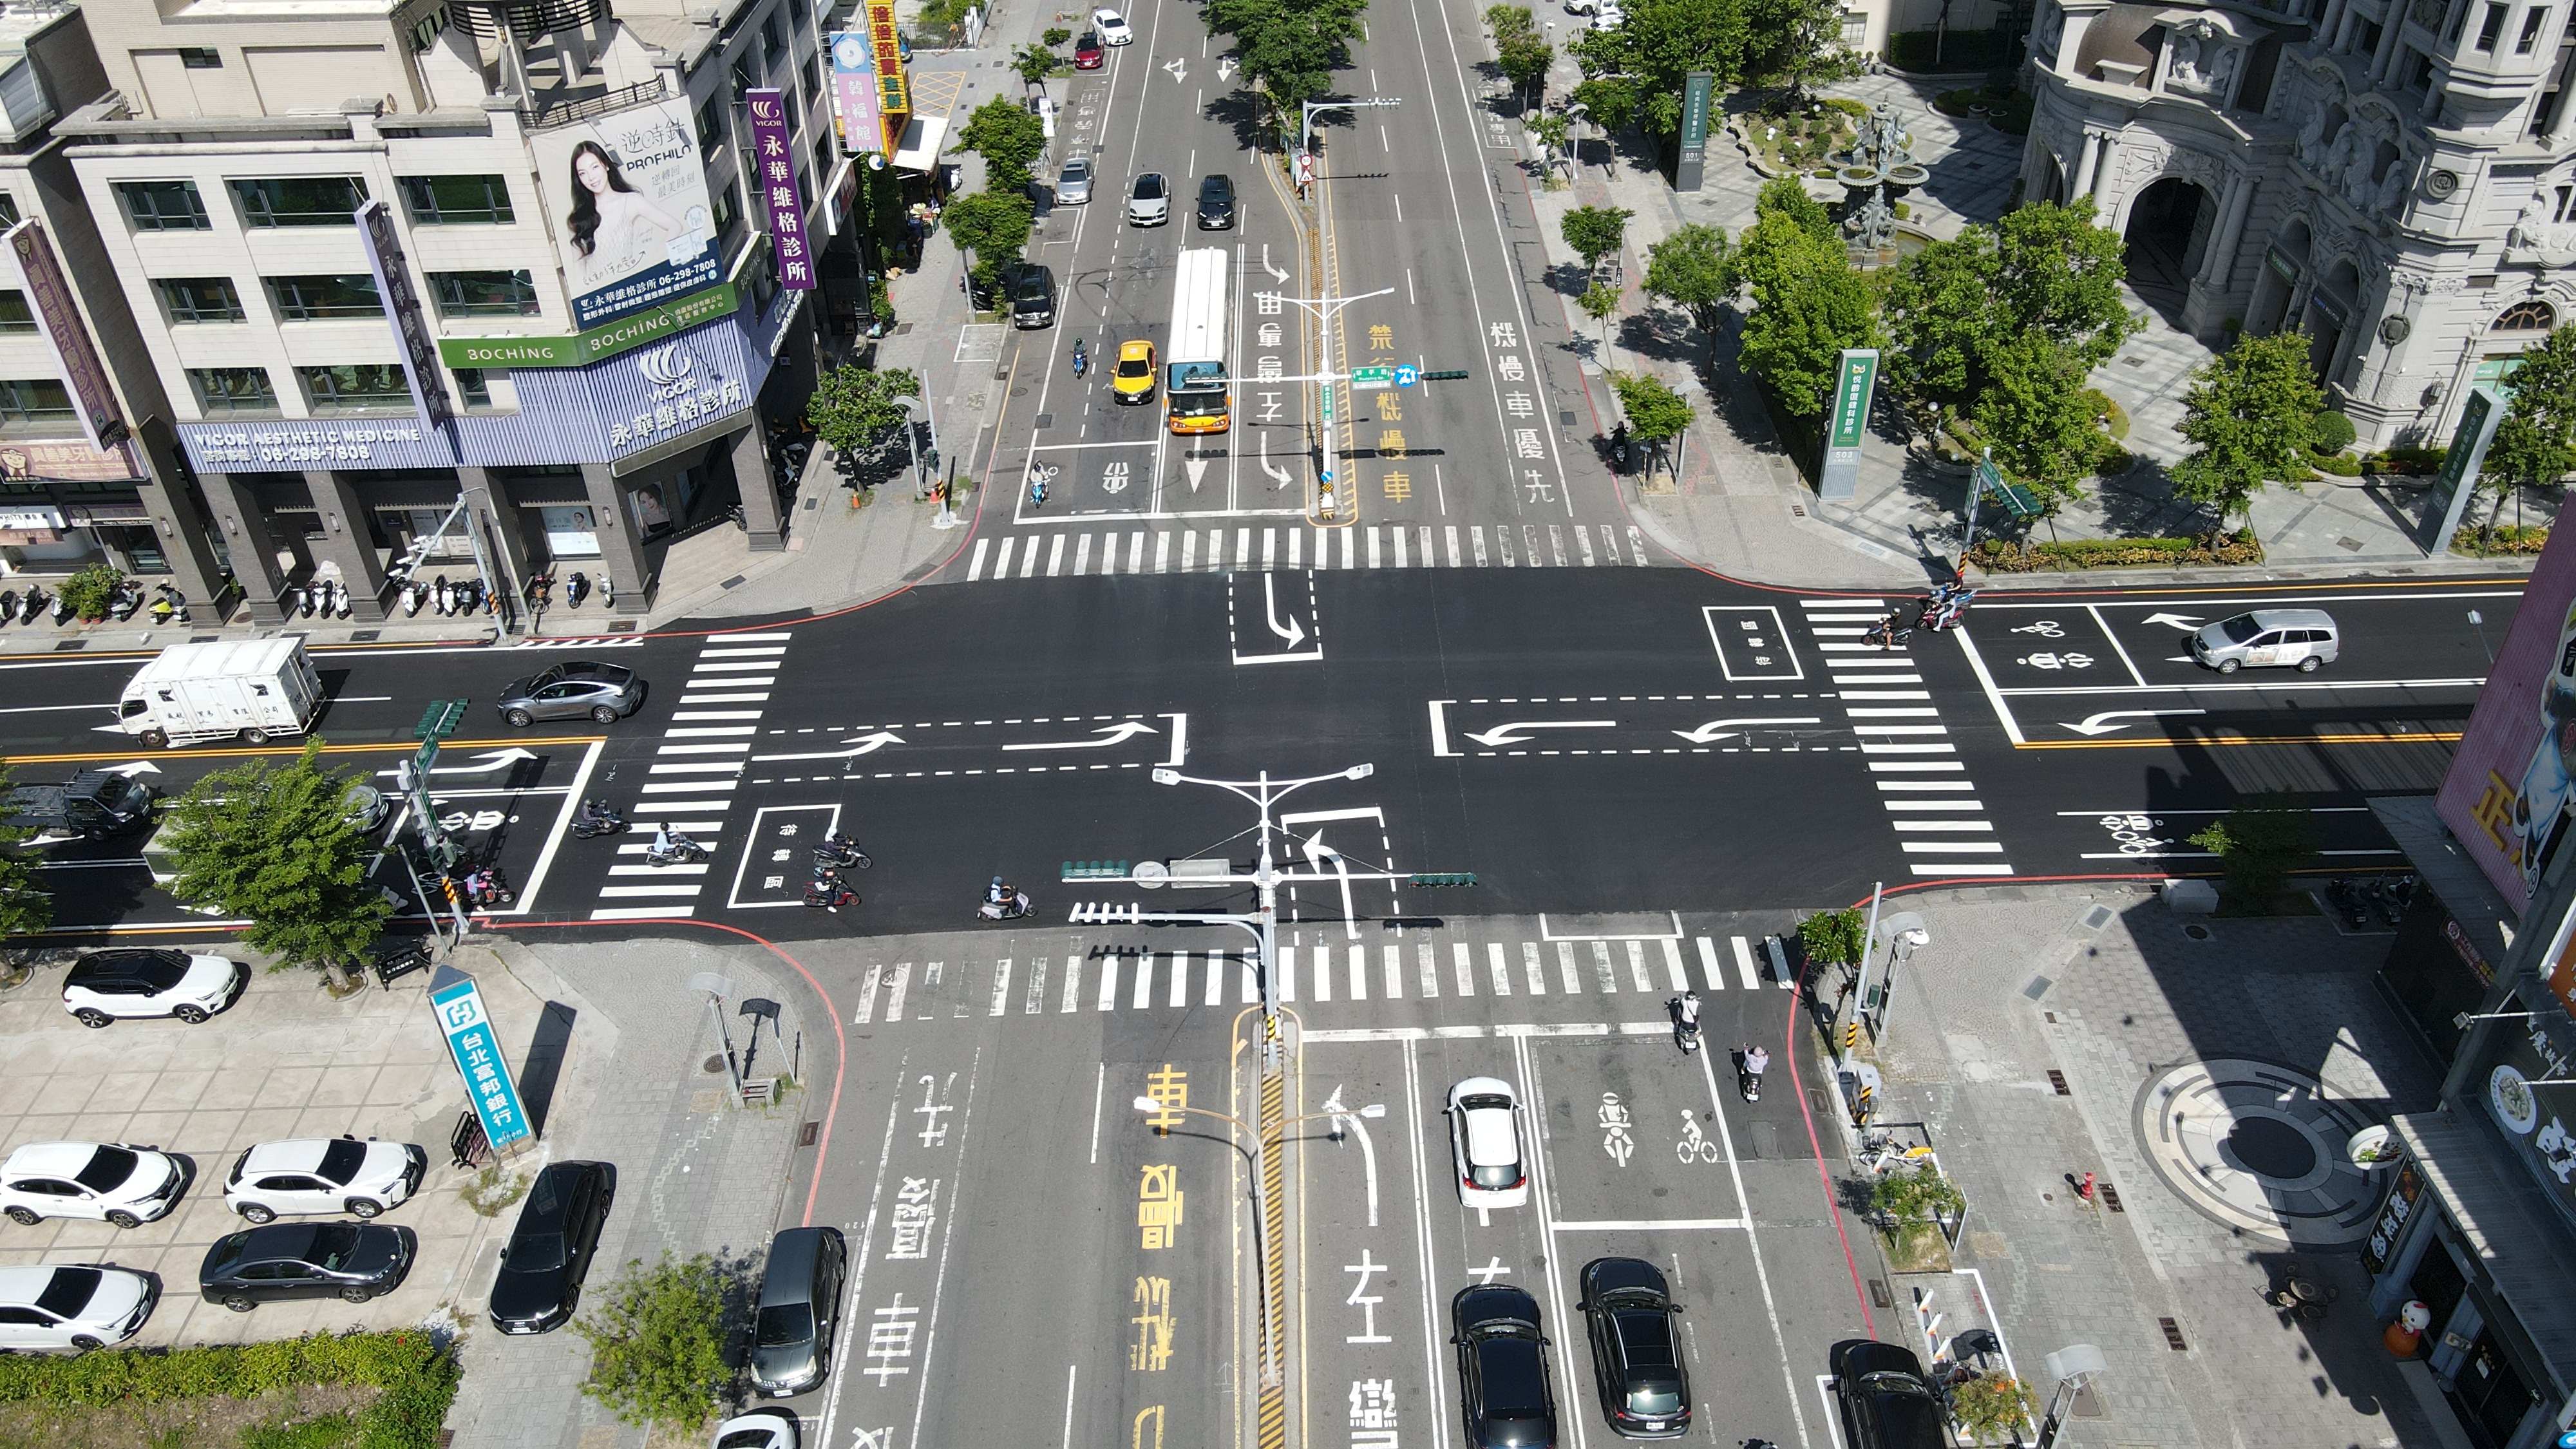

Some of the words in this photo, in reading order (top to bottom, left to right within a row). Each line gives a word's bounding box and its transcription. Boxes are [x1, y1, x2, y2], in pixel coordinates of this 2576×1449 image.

[627, 144, 692, 171] PROFHILO
[762, 135, 806, 281] 永華維格診所
[594, 278, 656, 307] 永華維格診所
[659, 259, 716, 287] 06-298-7808
[385, 256, 440, 418] 永華維格診所
[610, 379, 742, 448] 永華維格診所
[647, 377, 697, 404] VIGOR
[1490, 322, 1555, 504] 機慢車優先
[194, 431, 248, 447] VIGOR
[254, 430, 338, 446] AESTHETIC
[343, 428, 421, 444] MEDICINE
[261, 445, 370, 463] 06-298-7808
[462, 1032, 512, 1127] 台北富邦銀行
